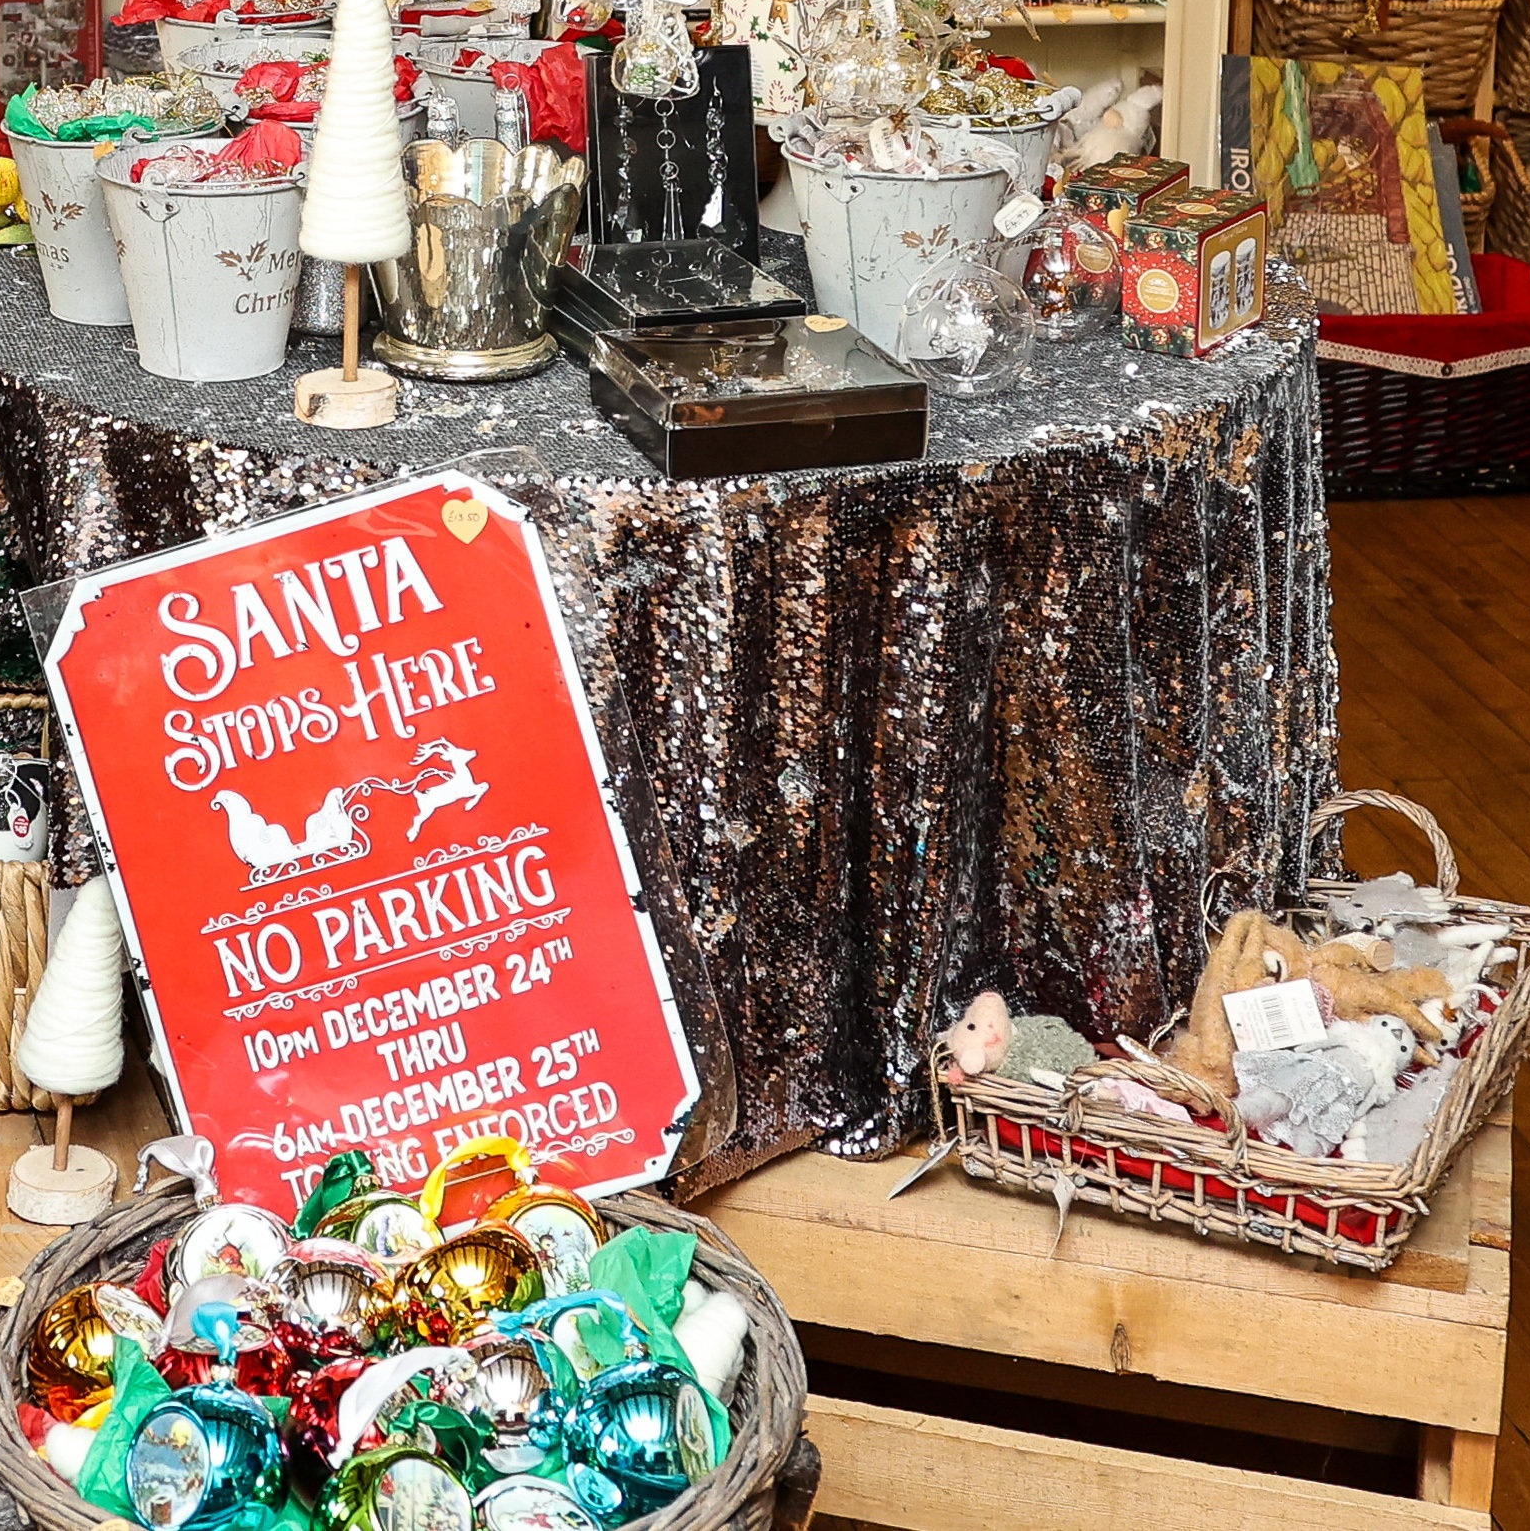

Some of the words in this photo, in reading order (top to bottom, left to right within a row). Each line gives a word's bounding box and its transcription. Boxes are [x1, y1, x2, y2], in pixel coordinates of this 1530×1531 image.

[157, 535, 444, 702] SANTA
[164, 687, 341, 791] STOPS
[342, 635, 496, 743] HERE
[212, 924, 302, 997] NO
[319, 844, 557, 972] PARKING
[326, 962, 501, 1050] DECEMBER
[507, 935, 575, 996] 24TH
[377, 1024, 467, 1082] THRU
[272, 1122, 337, 1163] 6AM
[339, 1056, 522, 1145] DECEMBER
[530, 1028, 601, 1088] 25TH
[280, 1148, 429, 1209] TOING
